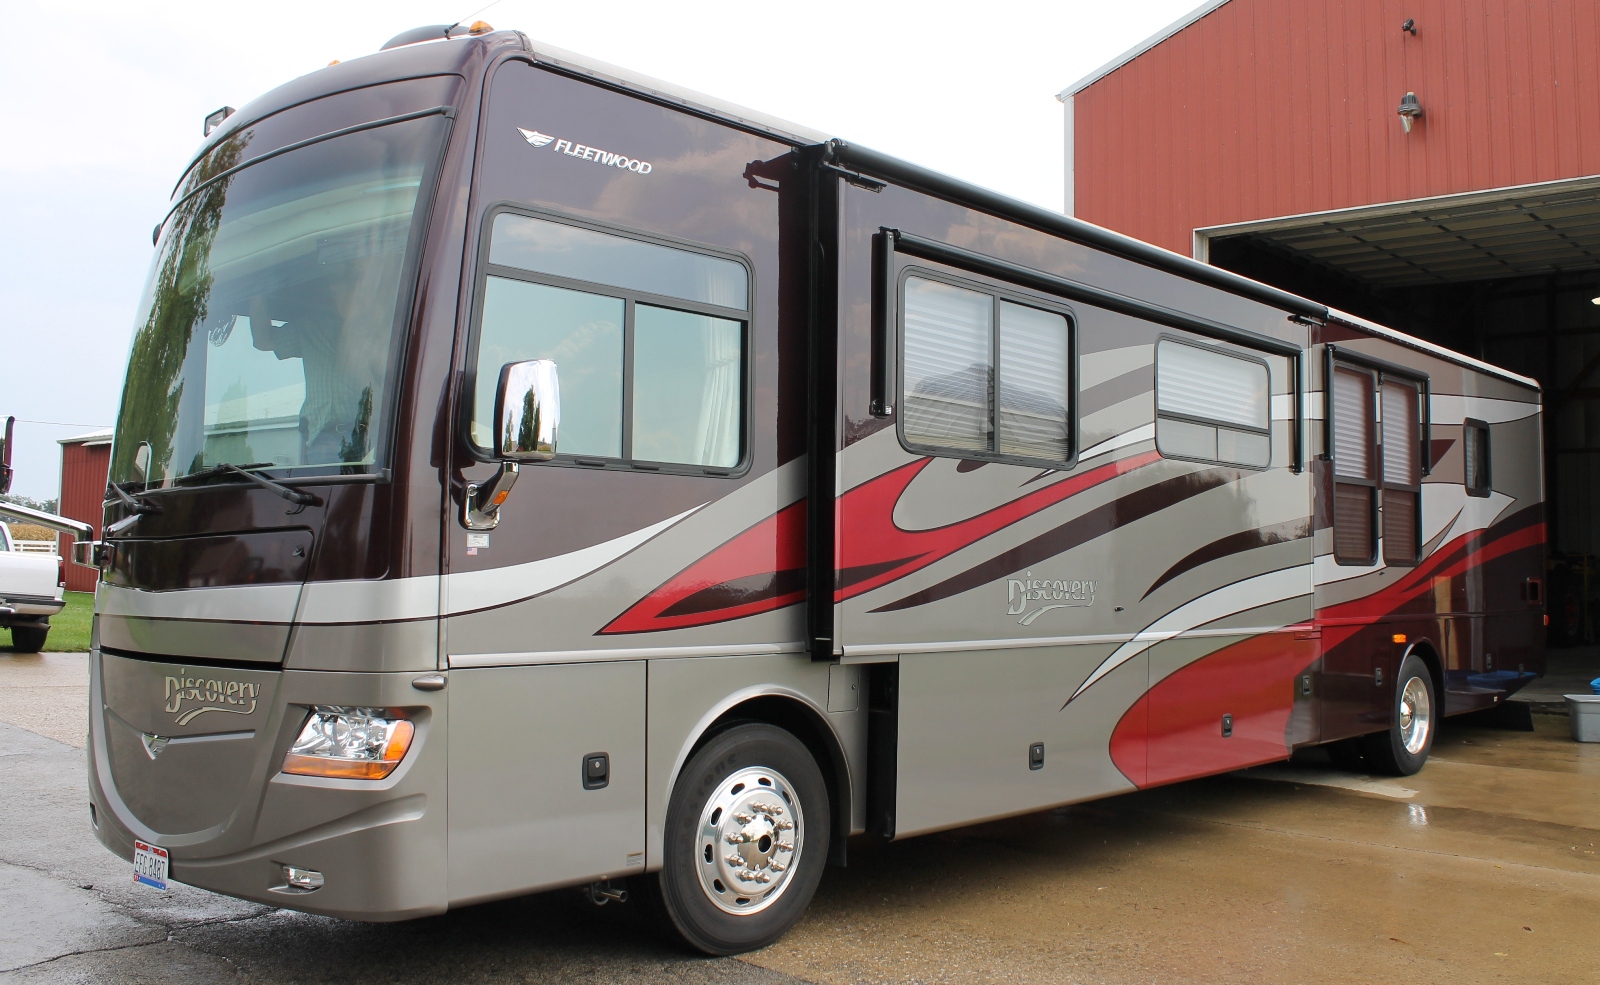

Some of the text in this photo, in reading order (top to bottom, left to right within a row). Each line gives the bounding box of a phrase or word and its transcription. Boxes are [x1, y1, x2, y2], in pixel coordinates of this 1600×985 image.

[554, 138, 652, 175] FLEETWOOD
[1007, 570, 1098, 626] Discovery
[165, 667, 260, 725] Discovery
